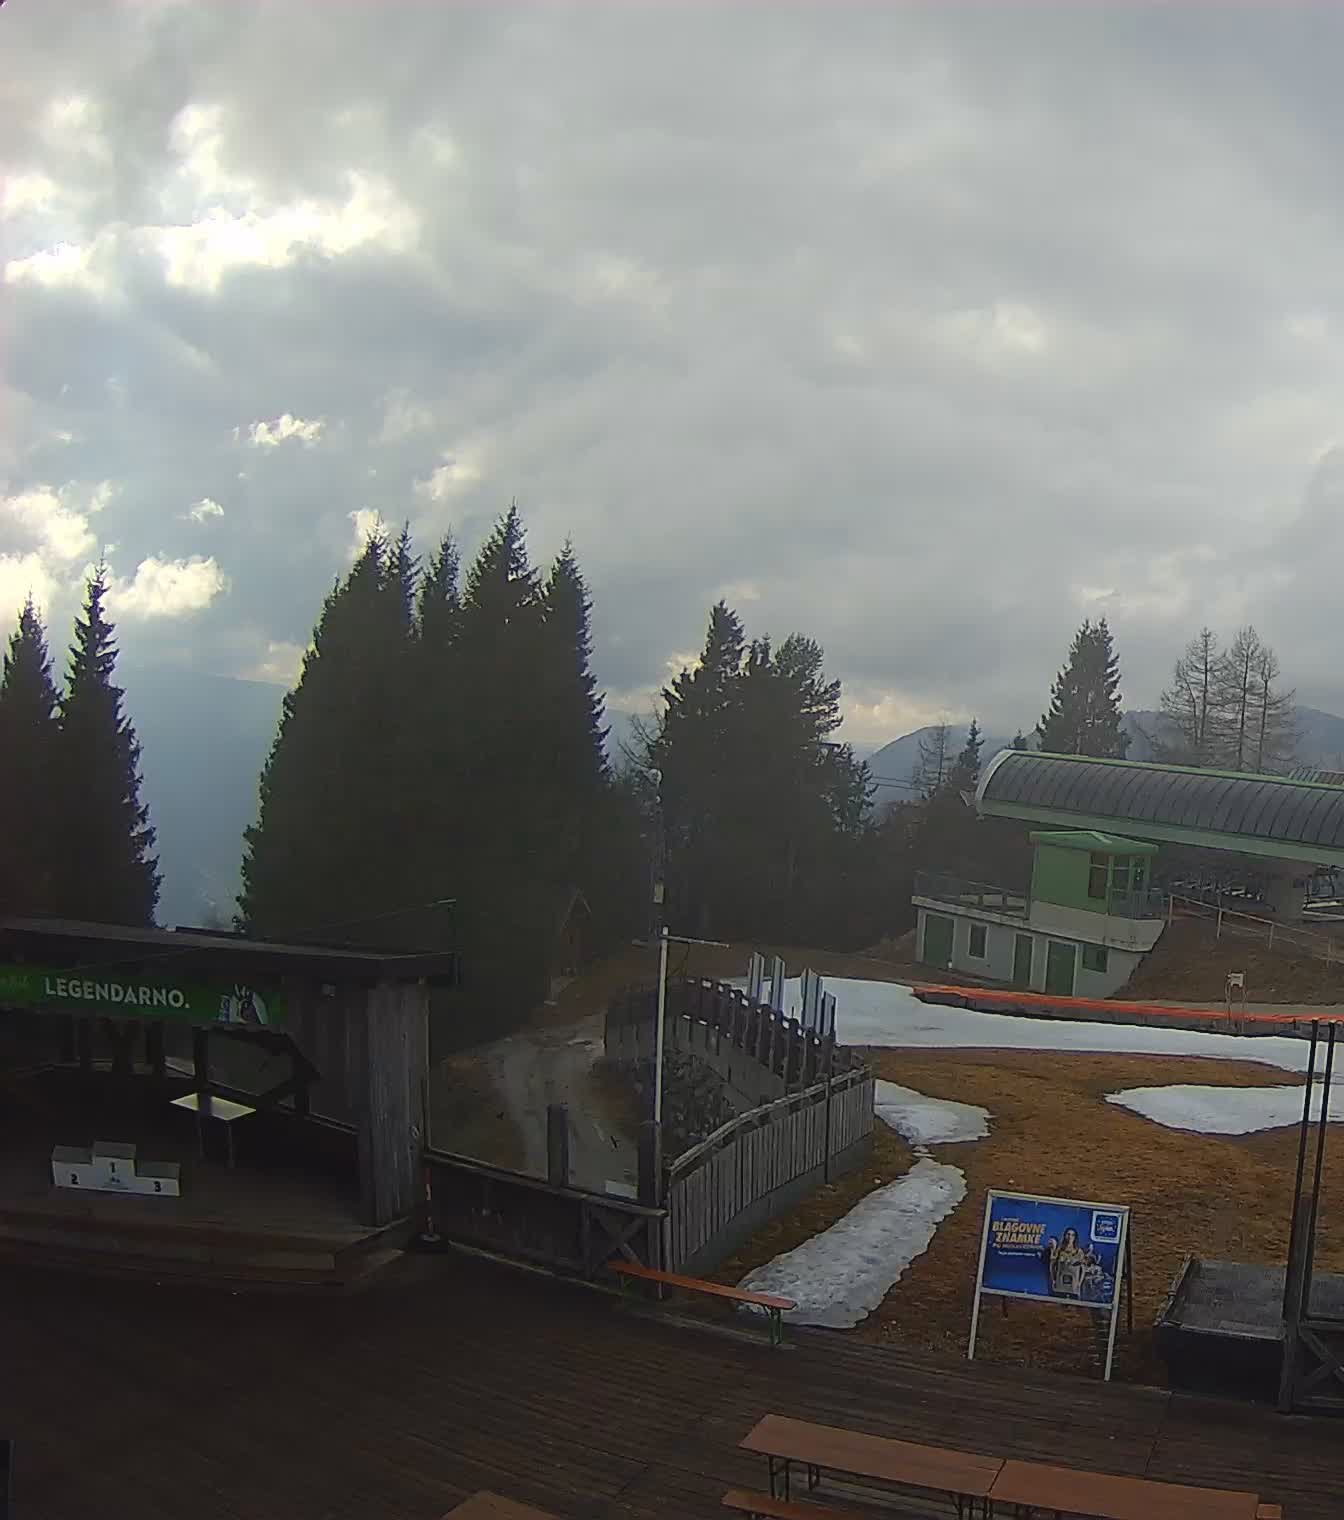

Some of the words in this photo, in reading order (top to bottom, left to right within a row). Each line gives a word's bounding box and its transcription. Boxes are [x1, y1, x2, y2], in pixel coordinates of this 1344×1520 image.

[45, 976, 191, 1009] LEGENDARNO.
[109, 1161, 117, 1174] 1
[70, 1173, 79, 1185] 2
[153, 1180, 162, 1193] 3
[992, 1221, 1047, 1233] BLAGOVNE
[995, 1231, 1041, 1245] ZNAMKE
